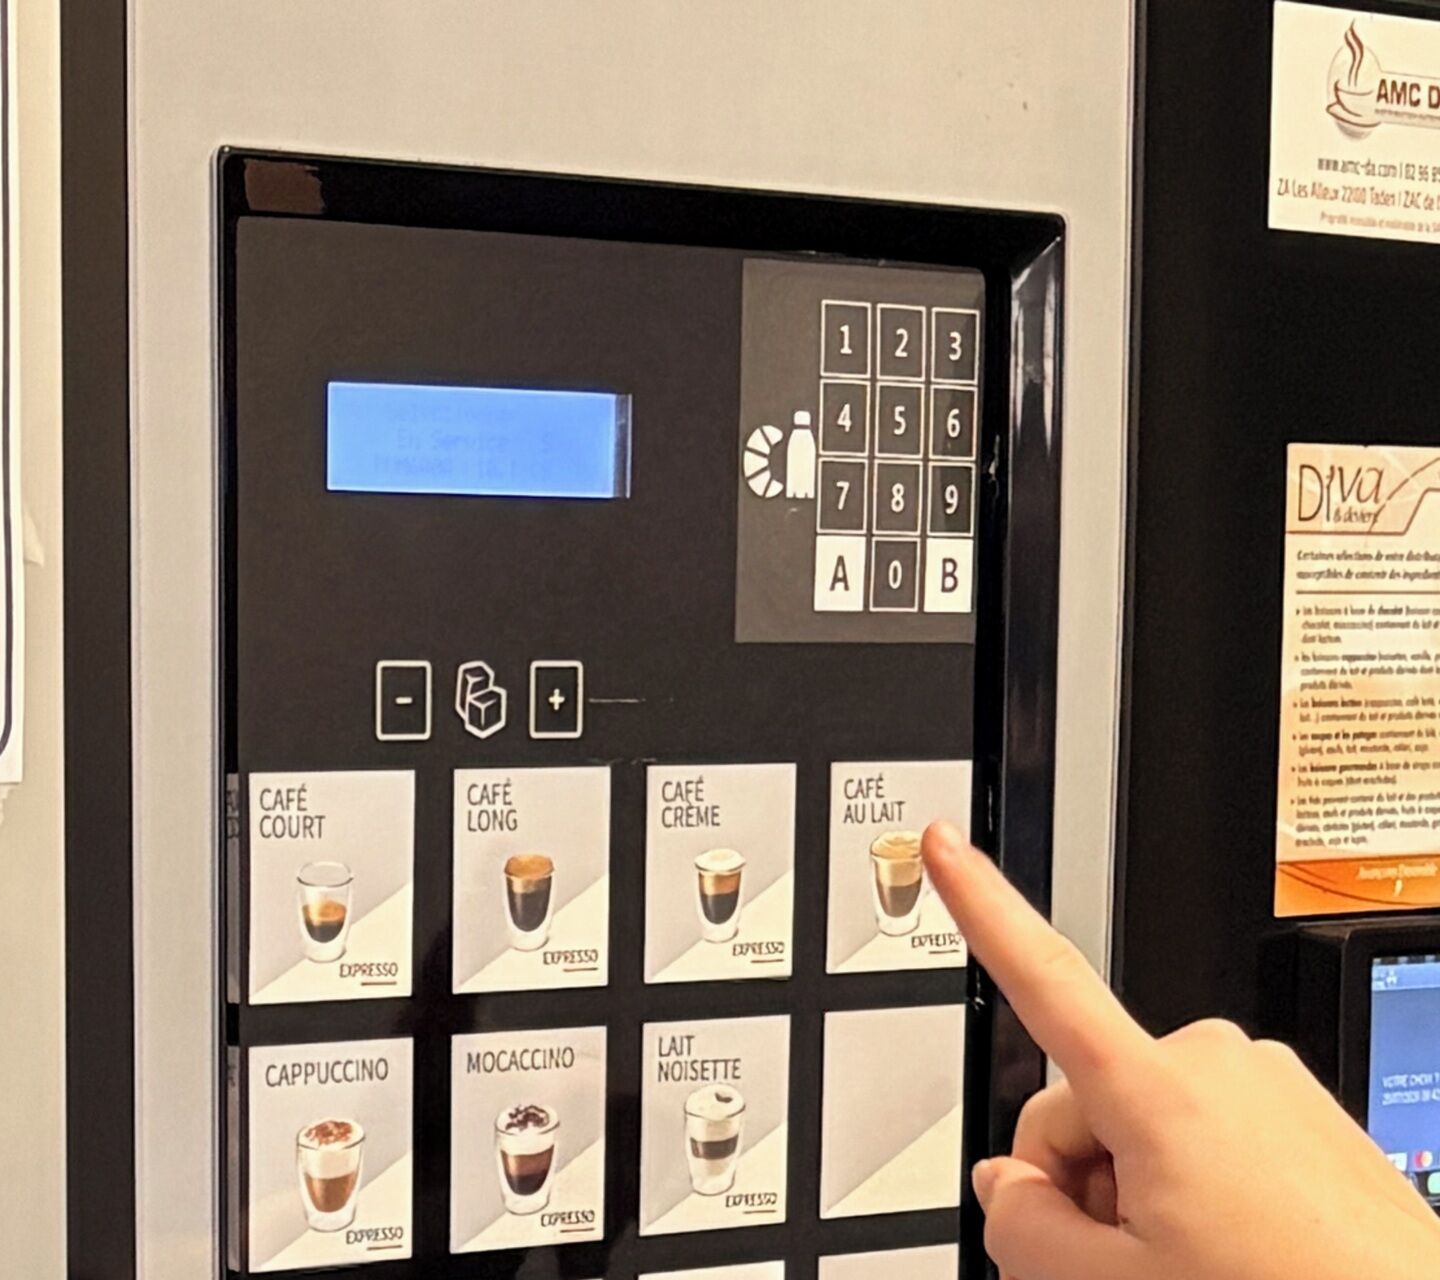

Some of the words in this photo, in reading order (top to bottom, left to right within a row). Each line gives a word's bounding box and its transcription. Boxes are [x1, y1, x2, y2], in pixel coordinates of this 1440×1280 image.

[1376, 78, 1421, 107] AMC
[839, 325, 852, 355] 1
[894, 328, 909, 358] 2
[948, 331, 962, 361] 3
[837, 403, 852, 433] 4
[893, 405, 907, 435] 5
[946, 408, 961, 438] 6
[836, 481, 850, 511] 7
[891, 483, 905, 513] 8
[944, 484, 959, 515] 9
[1298, 464, 1385, 522] Diva
[829, 554, 850, 592] A
[888, 559, 903, 590] 0
[940, 557, 959, 593] B
[259, 783, 308, 812] CAFÉ
[466, 777, 513, 806] CAFÉ
[661, 775, 705, 802] CAFÉ
[843, 772, 885, 800] CAFÉ
[466, 808, 519, 833] LONG
[661, 803, 721, 828] CRÈME
[843, 802, 866, 825] AU
[871, 800, 906, 824] LAIT
[259, 814, 326, 840] COURT
[543, 948, 599, 966] EXPRESSO
[732, 940, 785, 957] EXPRESSO
[339, 962, 399, 979] EXPRESSO
[658, 1035, 696, 1058] LAIT
[265, 1057, 390, 1088] CAPPUCCINO
[466, 1046, 575, 1074] MOCACCINO
[658, 1058, 742, 1083] NOISETTE
[725, 1192, 778, 1209] EXPRESSO
[540, 1209, 595, 1228] EXPRESSO
[346, 1226, 404, 1246] EXPRESSO
